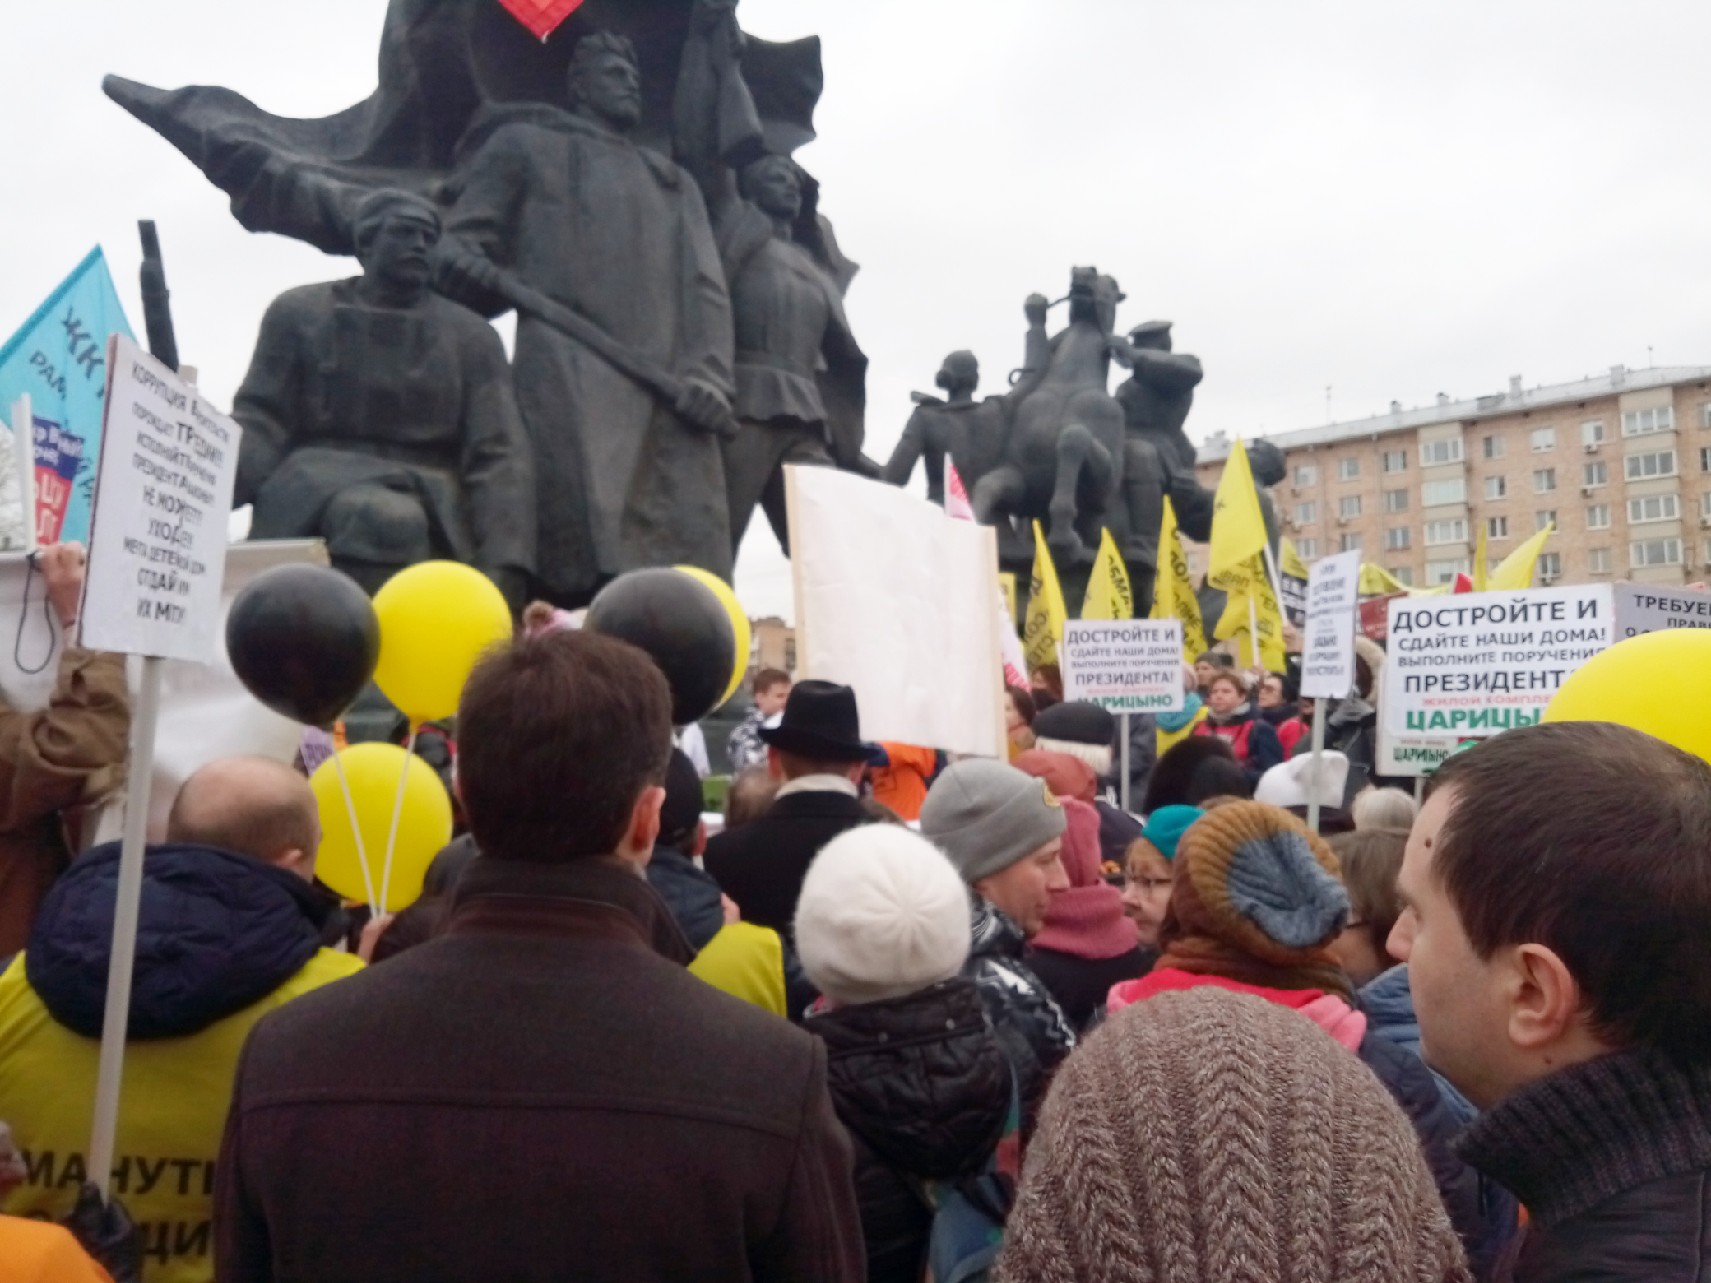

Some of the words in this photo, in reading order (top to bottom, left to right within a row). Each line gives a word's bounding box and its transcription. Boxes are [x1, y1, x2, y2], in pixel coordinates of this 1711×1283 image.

[1393, 598, 1566, 633] ДОСТРОЙТЕ
[1577, 599, 1598, 619] И
[1632, 594, 1711, 616] ТРЕБУЕ
[1068, 625, 1159, 645] ДОСТРОЙТЕ
[1165, 628, 1174, 640] И
[1398, 633, 1469, 653] СДАЙТЕ
[1476, 630, 1533, 647] НАШИ
[1539, 627, 1606, 646] ДОМА!
[1071, 647, 1112, 658] СДАЙТЕ
[1114, 647, 1144, 657] НАШИ
[1147, 646, 1179, 657] ДОМА!
[1397, 651, 1496, 668] ВЫПОЛНИТЕ
[1075, 672, 1174, 687] ПРЕЗИДЕНТА!
[1404, 669, 1575, 693] ПРЕЗИДЕНТ
[1077, 693, 1174, 709] АРИЦЫНО
[1406, 707, 1541, 731] ЦАРИЦЫ
[21, 1150, 215, 1195] МАНУТ
